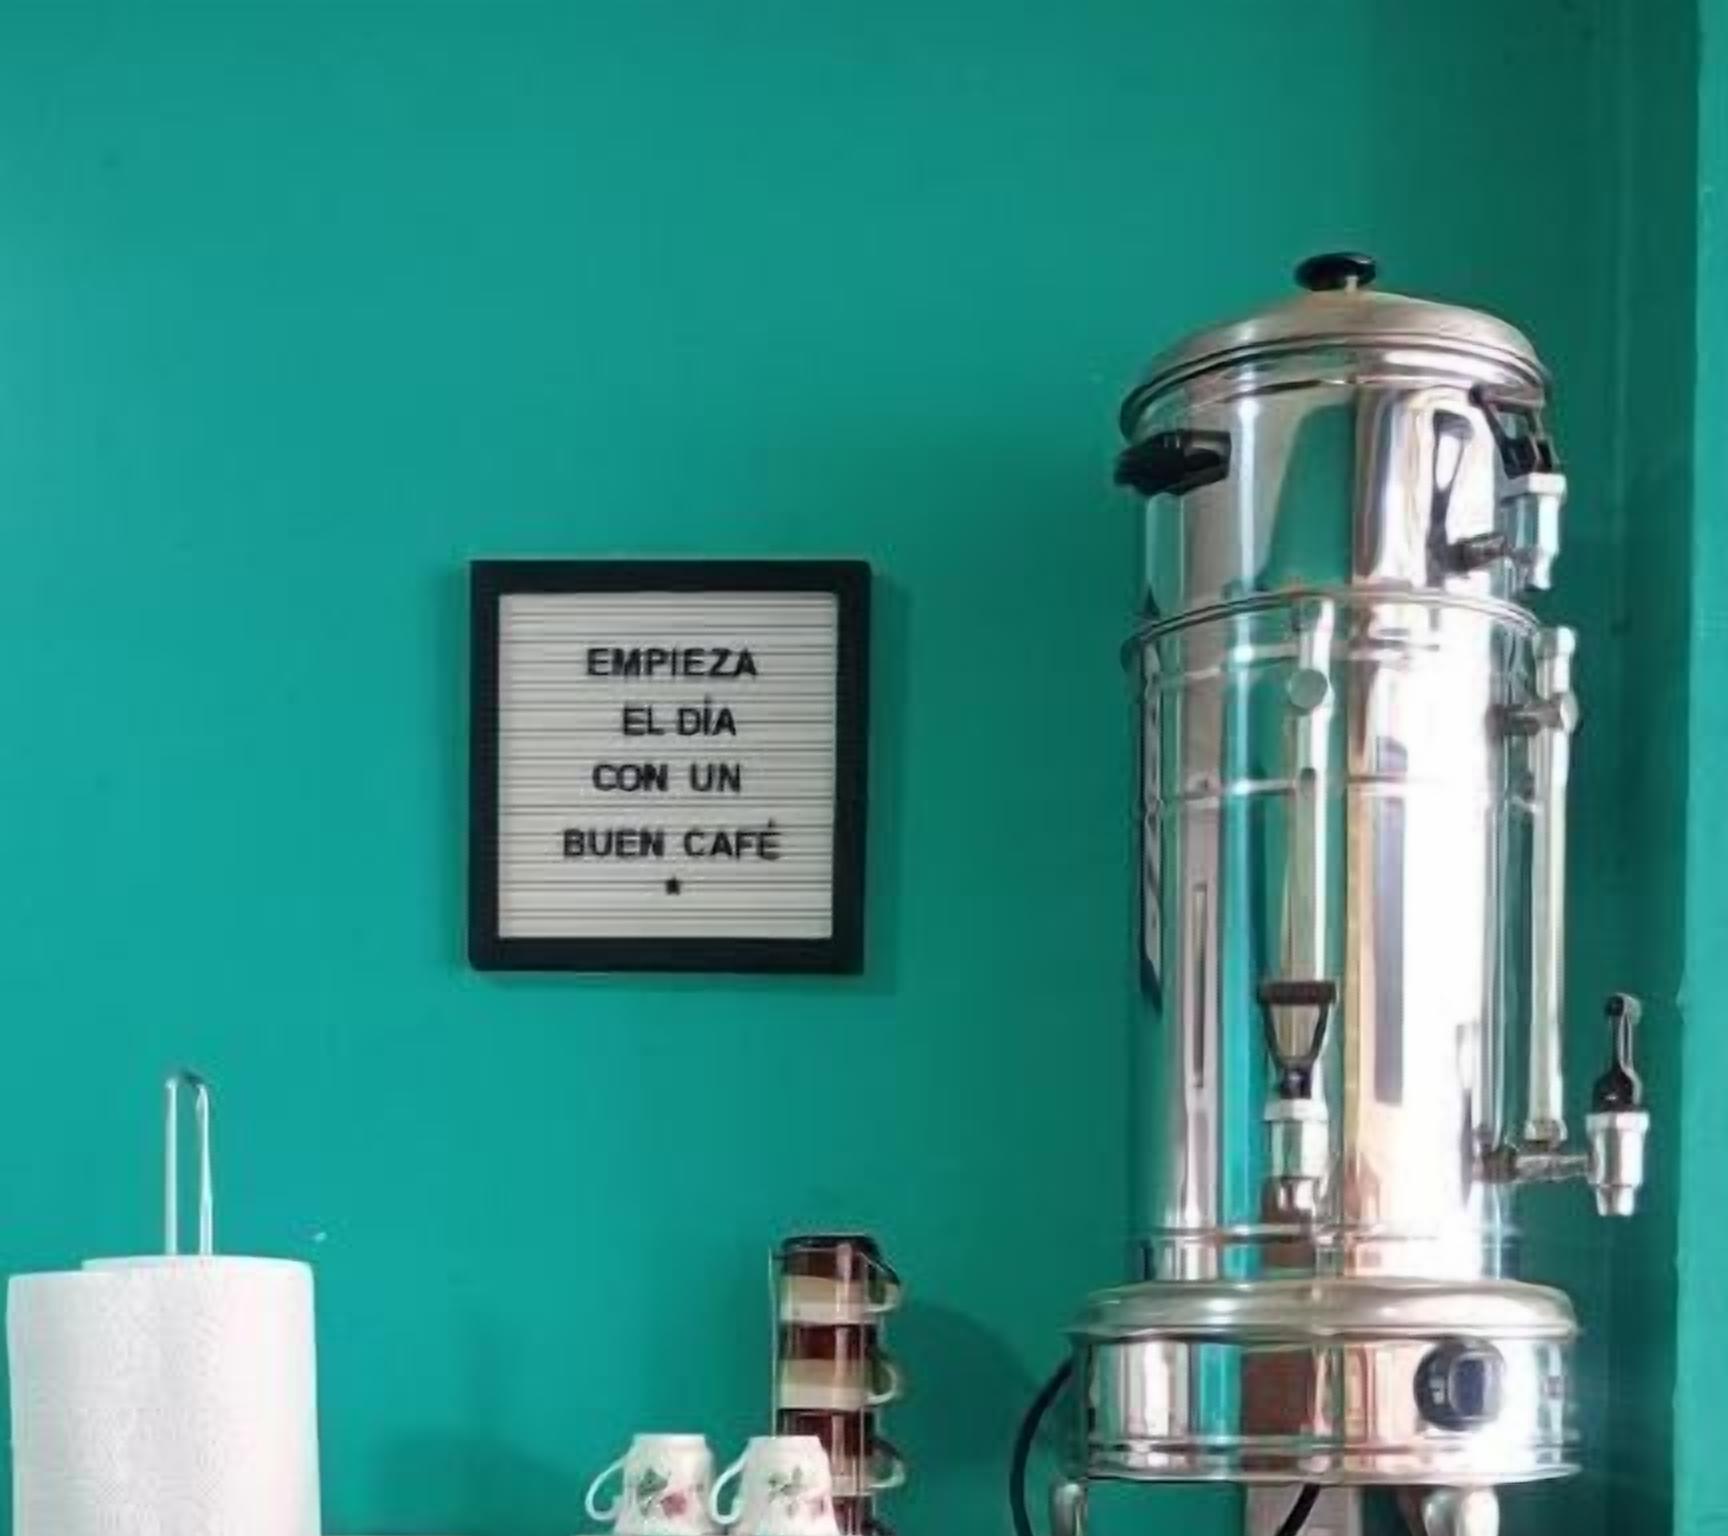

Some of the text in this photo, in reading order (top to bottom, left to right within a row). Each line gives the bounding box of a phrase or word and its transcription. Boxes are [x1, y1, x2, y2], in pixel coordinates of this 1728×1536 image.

[586, 647, 758, 677] EMPIEZA
[622, 694, 737, 736] EL DÍA
[592, 763, 741, 792] CON UN
[562, 818, 782, 860] BUEN CAFÉ
